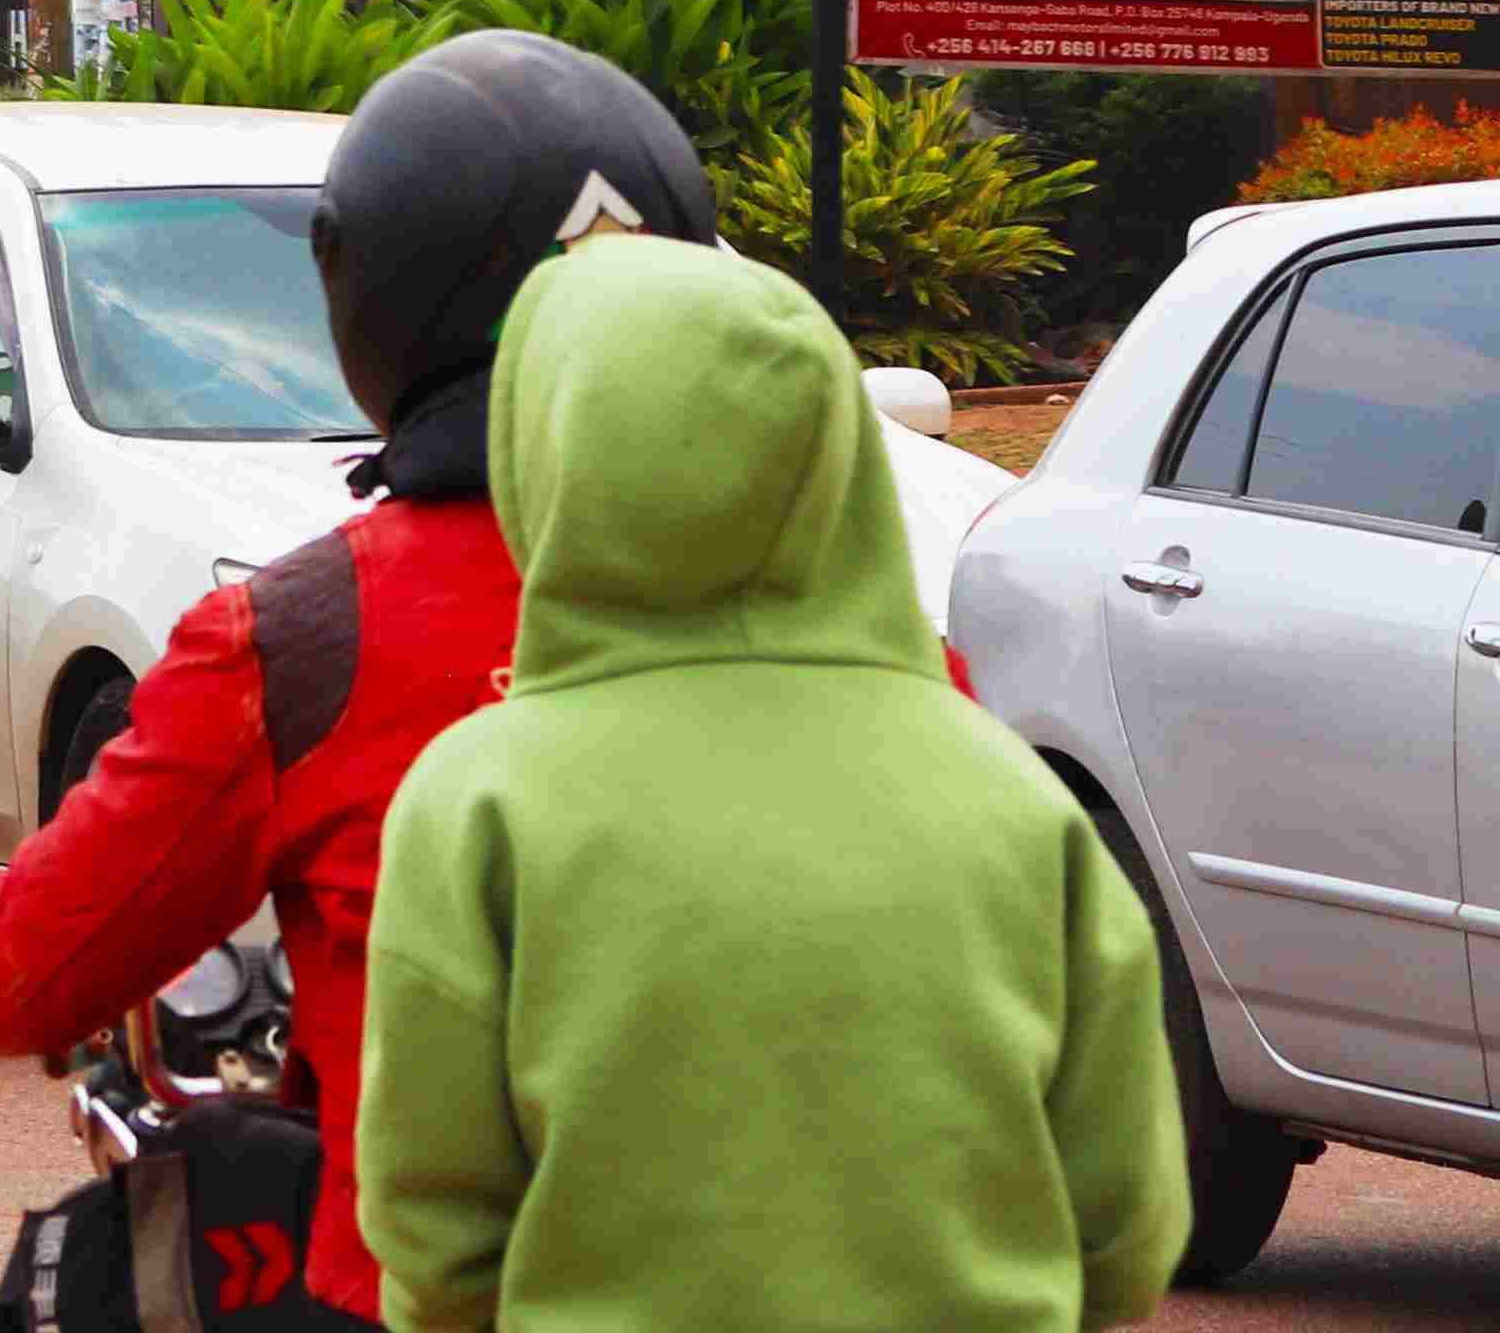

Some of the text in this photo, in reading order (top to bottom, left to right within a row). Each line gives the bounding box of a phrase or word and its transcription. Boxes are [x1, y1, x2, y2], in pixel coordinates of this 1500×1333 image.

[903, 1, 924, 13] No.
[1325, 0, 1500, 15] IMPORTERS OF BRAND NEW
[965, 20, 1004, 32] Email:
[1325, 16, 1475, 31] TOYOTA LANDCRUISER
[1325, 33, 1427, 46] TOYOTA PRADO
[926, 38, 973, 54] +256
[1109, 42, 1156, 60] +256
[1326, 50, 1380, 63] TOYOTA
[1381, 51, 1422, 63] HILUX
